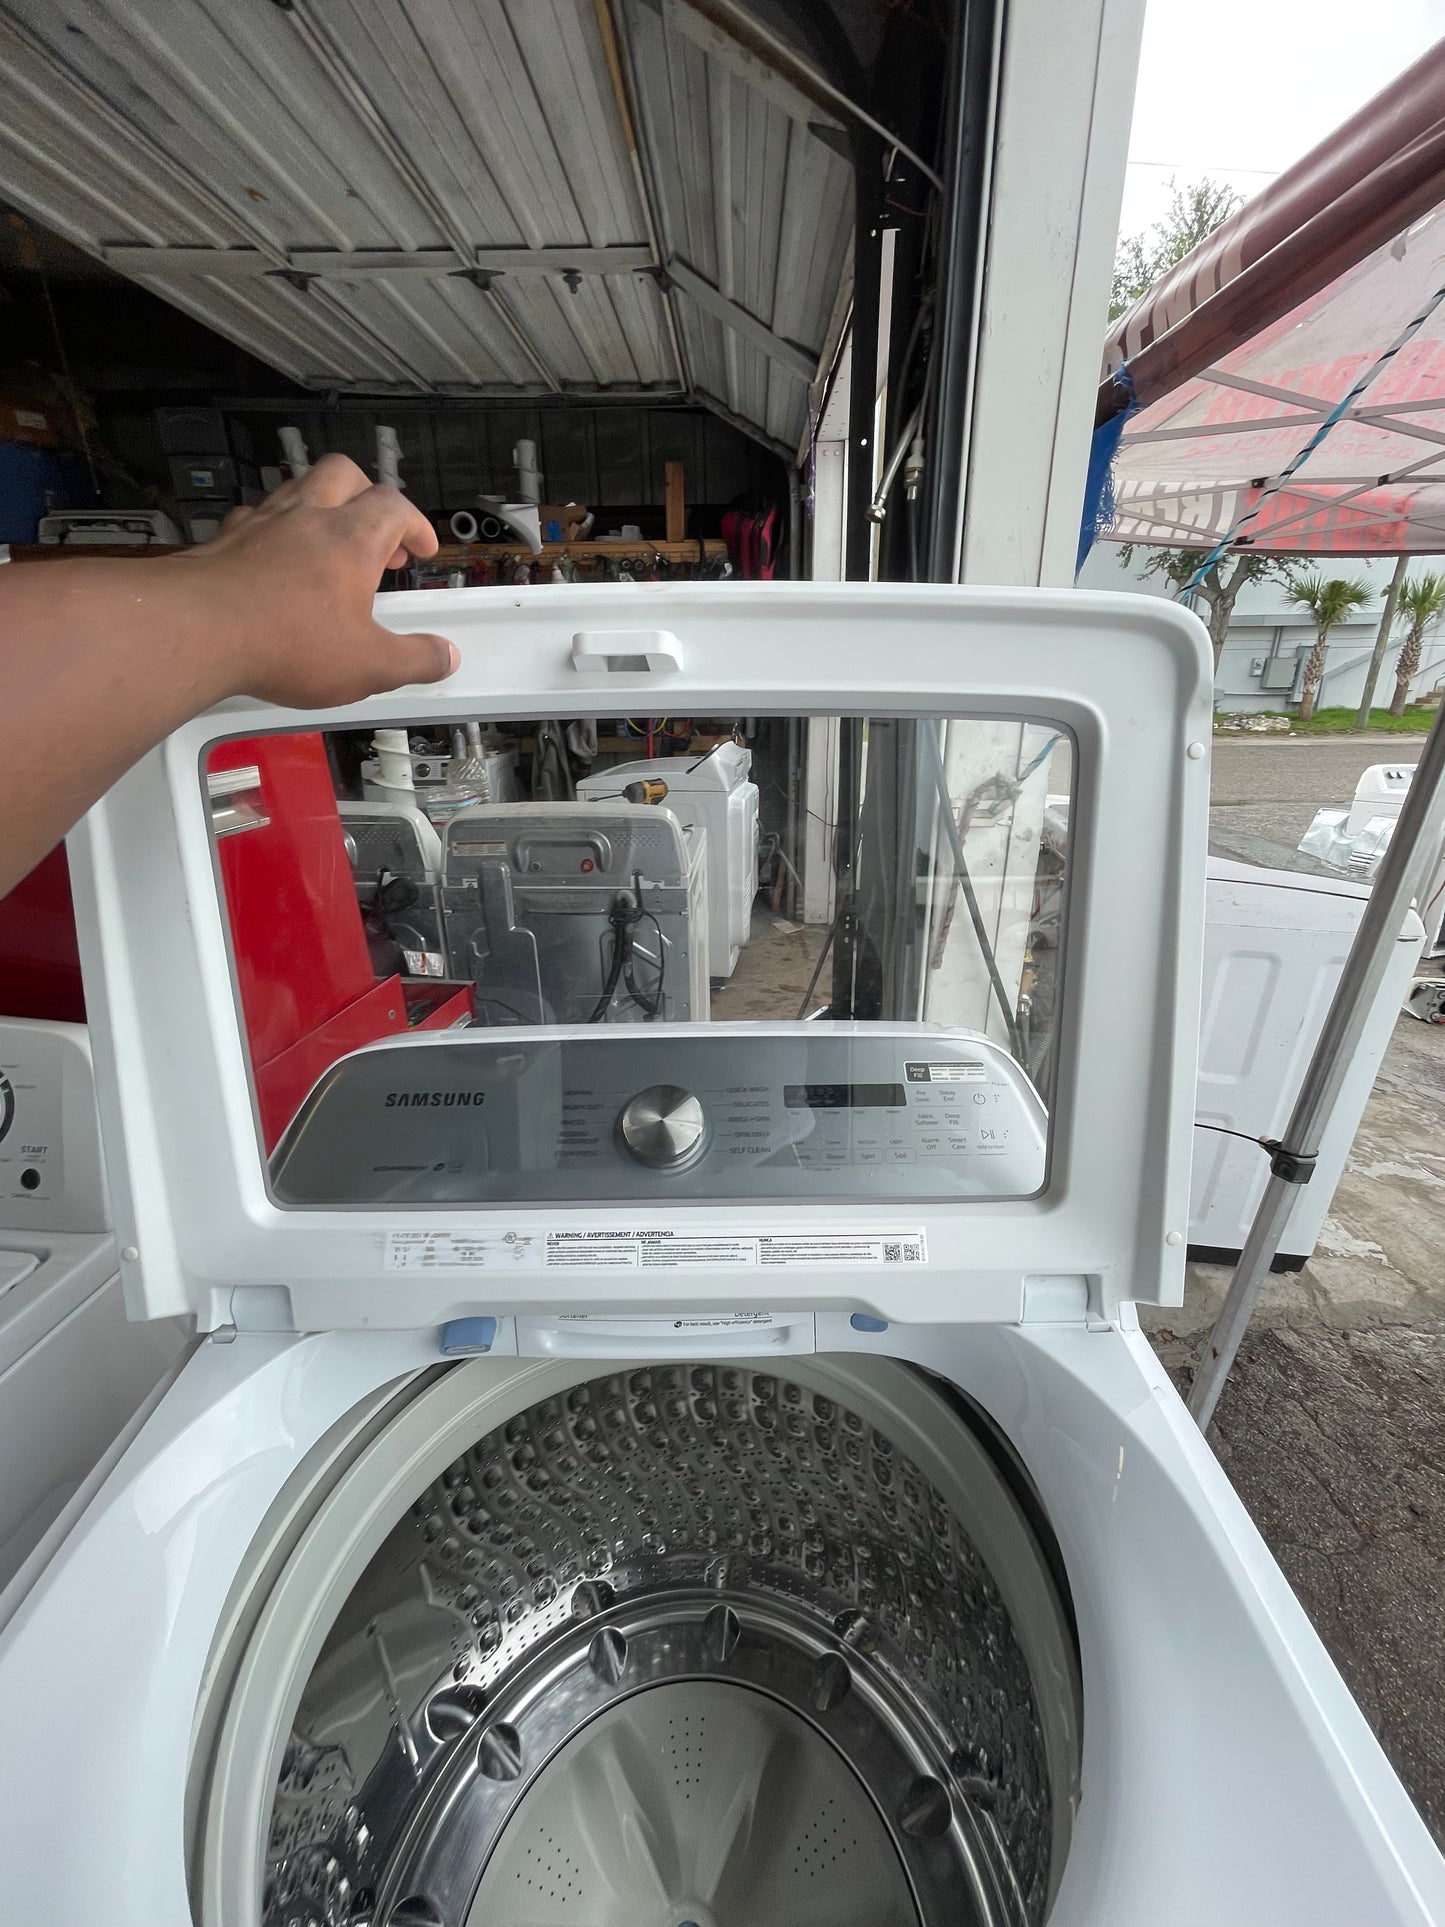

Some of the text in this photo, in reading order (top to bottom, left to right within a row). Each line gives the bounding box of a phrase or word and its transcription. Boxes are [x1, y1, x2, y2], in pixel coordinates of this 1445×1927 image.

[385, 1092, 485, 1107] SAMSUNG
[20, 1145, 49, 1154] START
[729, 1146, 746, 1154] SELF
[926, 1143, 937, 1151] Off
[860, 1152, 876, 1161] Spin
[893, 1151, 908, 1159] Soil
